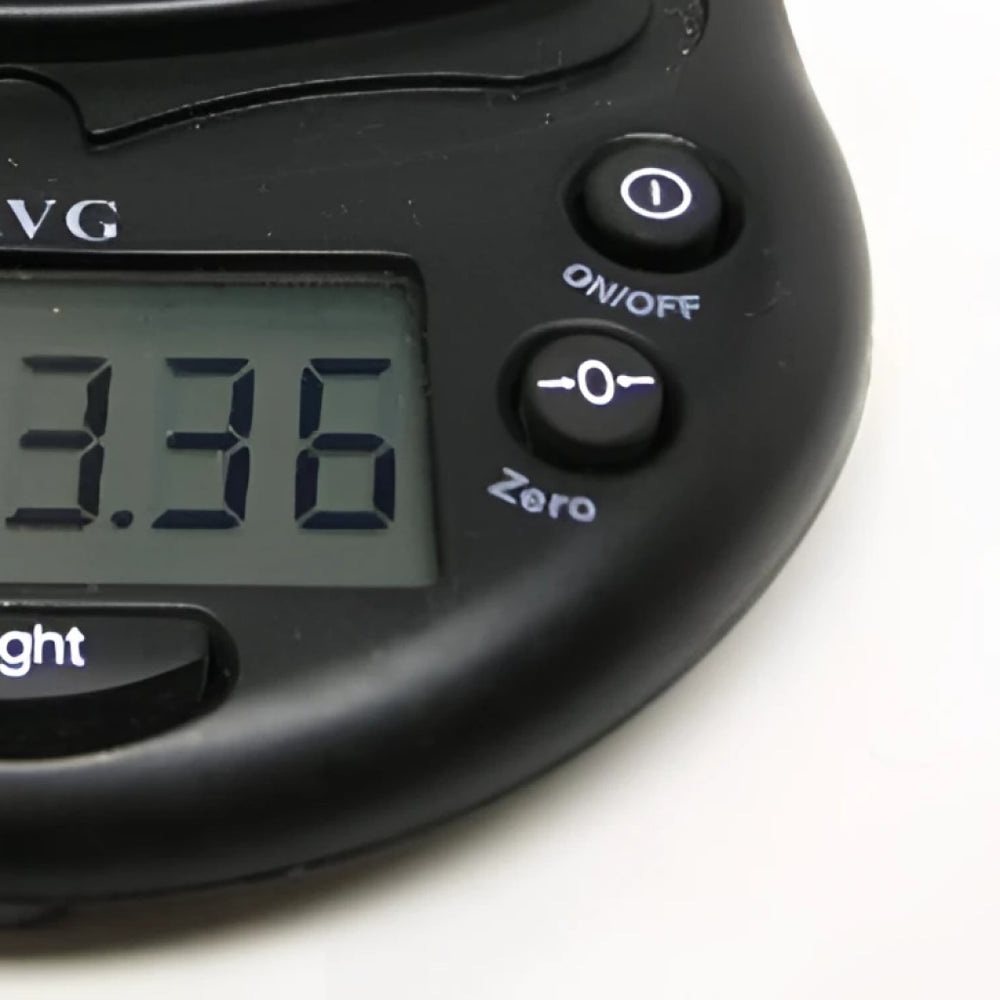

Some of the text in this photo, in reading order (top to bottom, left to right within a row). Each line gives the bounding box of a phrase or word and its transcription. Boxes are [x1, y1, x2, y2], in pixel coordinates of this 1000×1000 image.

[562, 263, 700, 319] ON/OFF
[5, 355, 397, 530] 3.36
[487, 467, 596, 522] Zero
